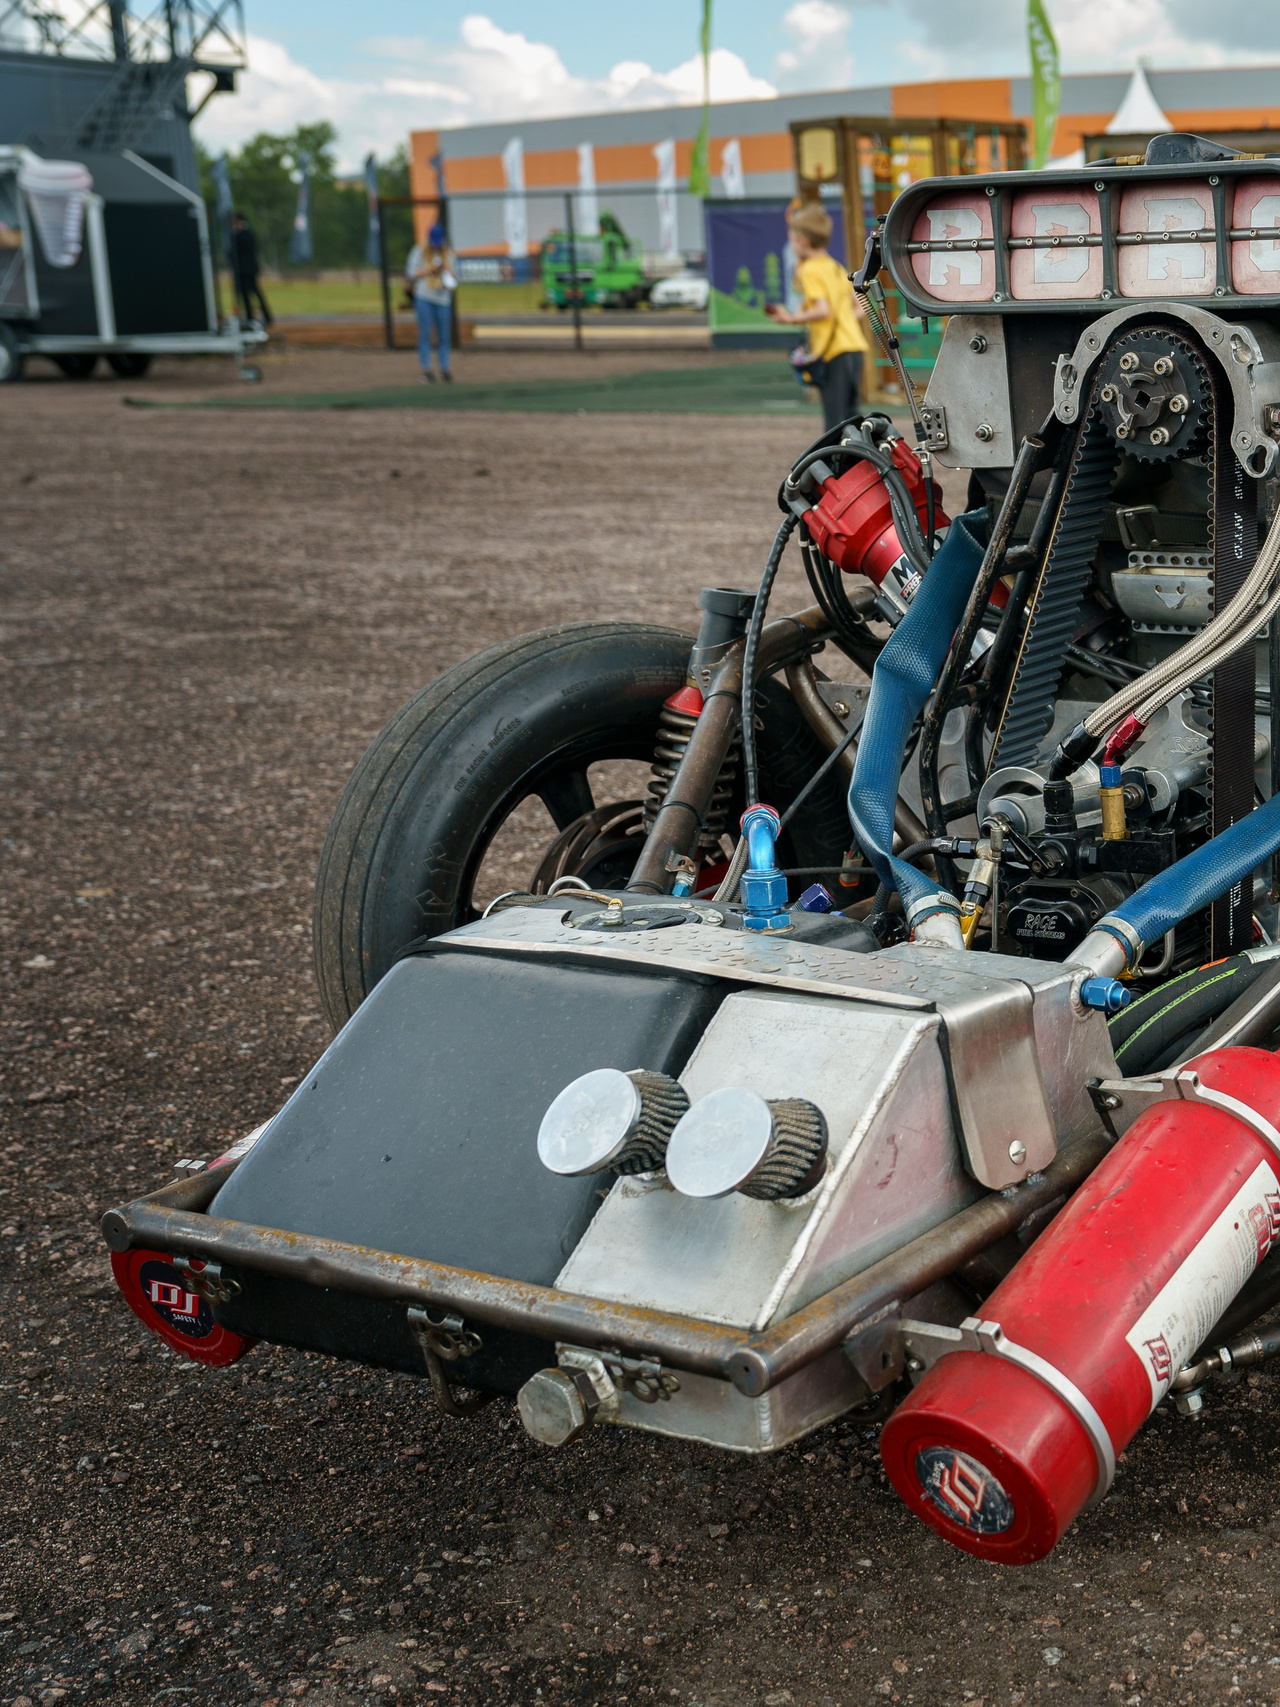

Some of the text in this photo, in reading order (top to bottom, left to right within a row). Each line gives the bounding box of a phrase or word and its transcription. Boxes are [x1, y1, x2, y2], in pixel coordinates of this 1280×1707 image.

[1024, 914, 1058, 930] RAGE
[148, 1280, 199, 1316] DJ
[172, 1313, 196, 1324] SAFETY
[1143, 1332, 1171, 1382] DJ
[940, 1454, 986, 1525] DJ
